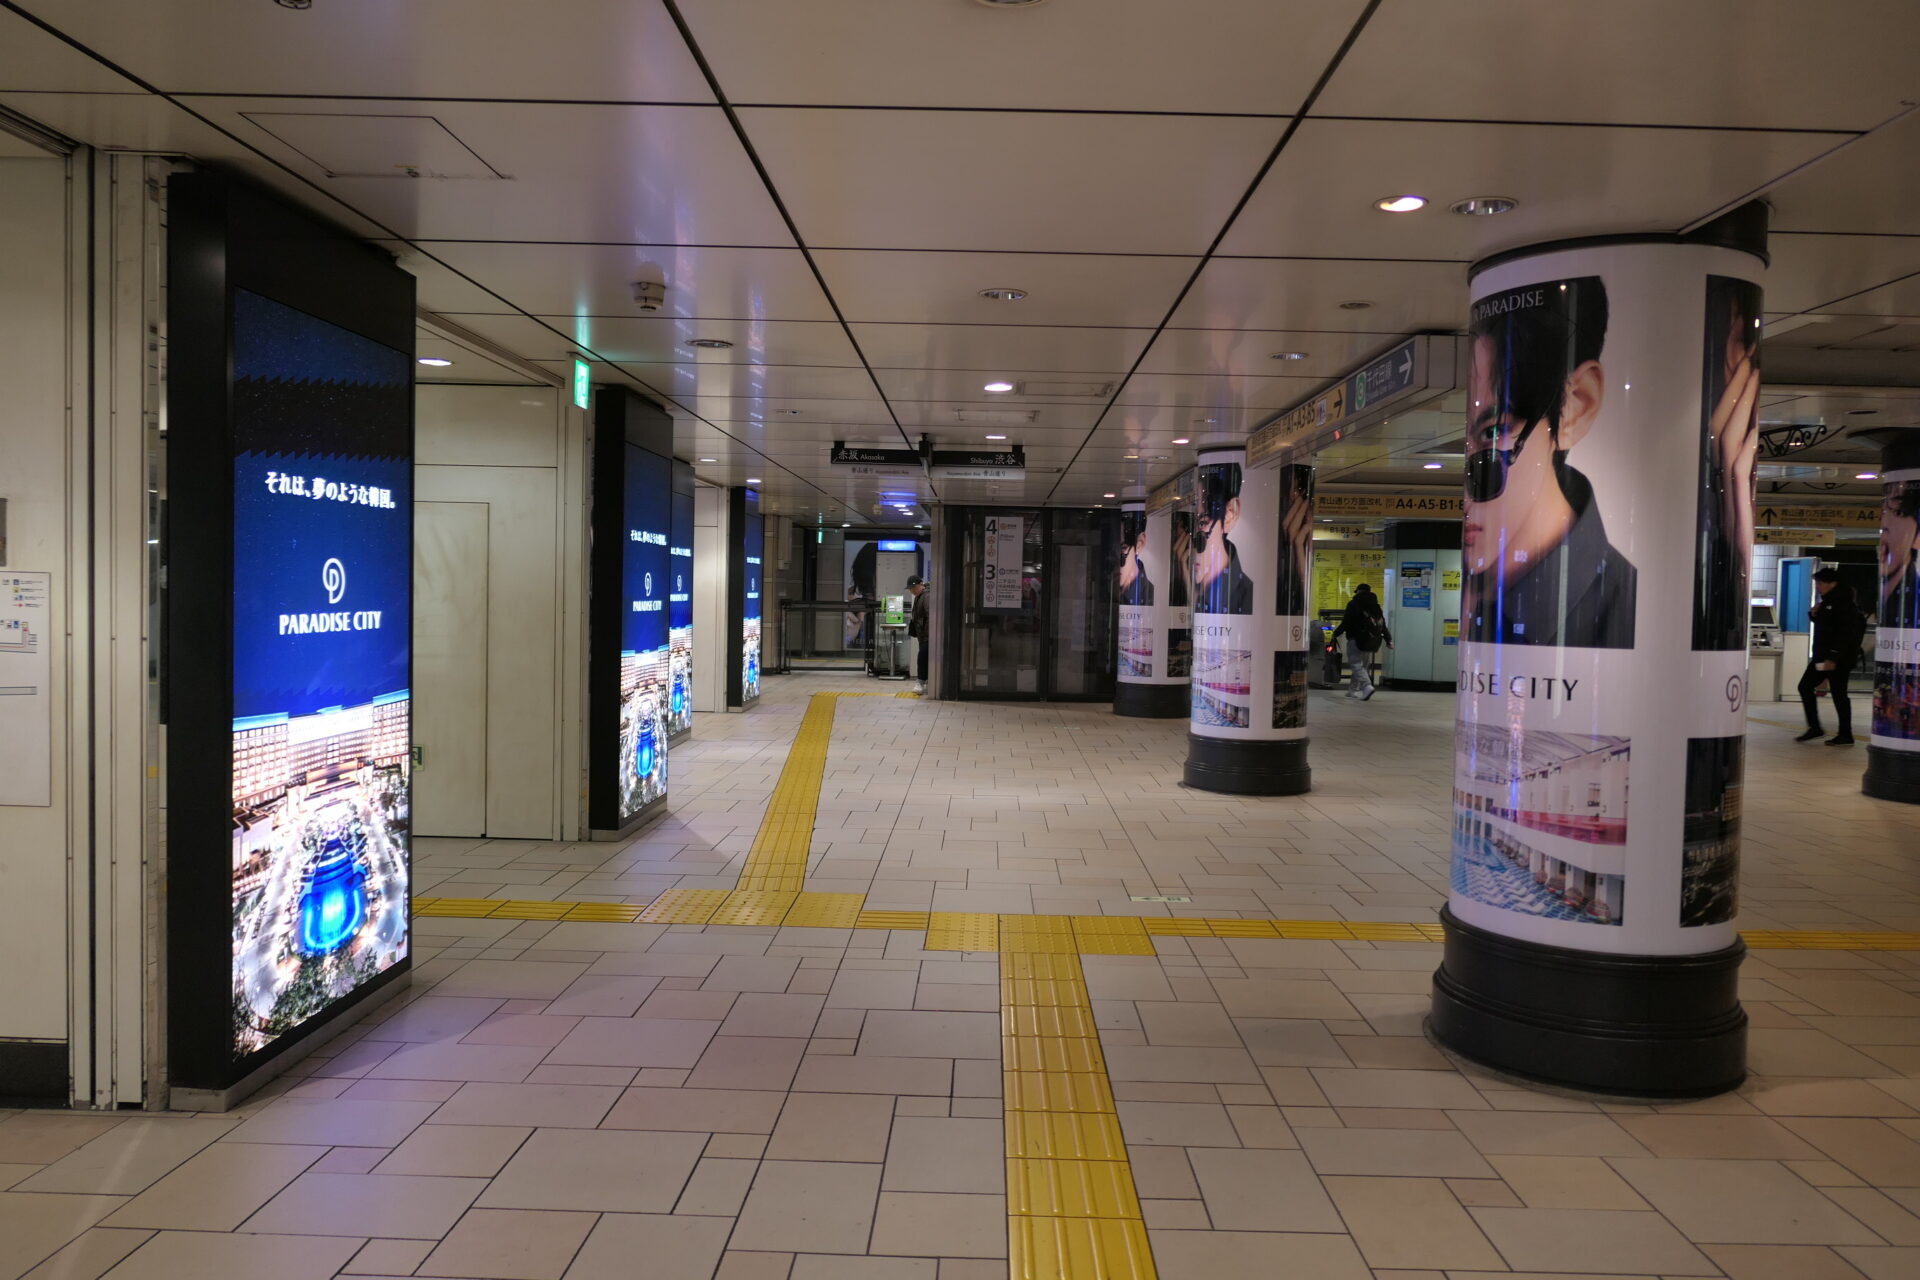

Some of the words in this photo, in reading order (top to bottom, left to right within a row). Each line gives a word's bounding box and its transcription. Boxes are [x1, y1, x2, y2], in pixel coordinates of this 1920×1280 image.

[1480, 290, 1544, 320] PARADISE
[838, 449, 858, 461] 赤坂
[995, 454, 1016, 465] 渋谷
[265, 471, 396, 509] それは、夢のような韓国。
[986, 519, 997, 535] 4
[985, 564, 995, 580] 3
[279, 612, 351, 635] PARADISE
[353, 611, 382, 631] CITY
[1207, 626, 1232, 637] CITY
[1510, 675, 1578, 701] CITY
